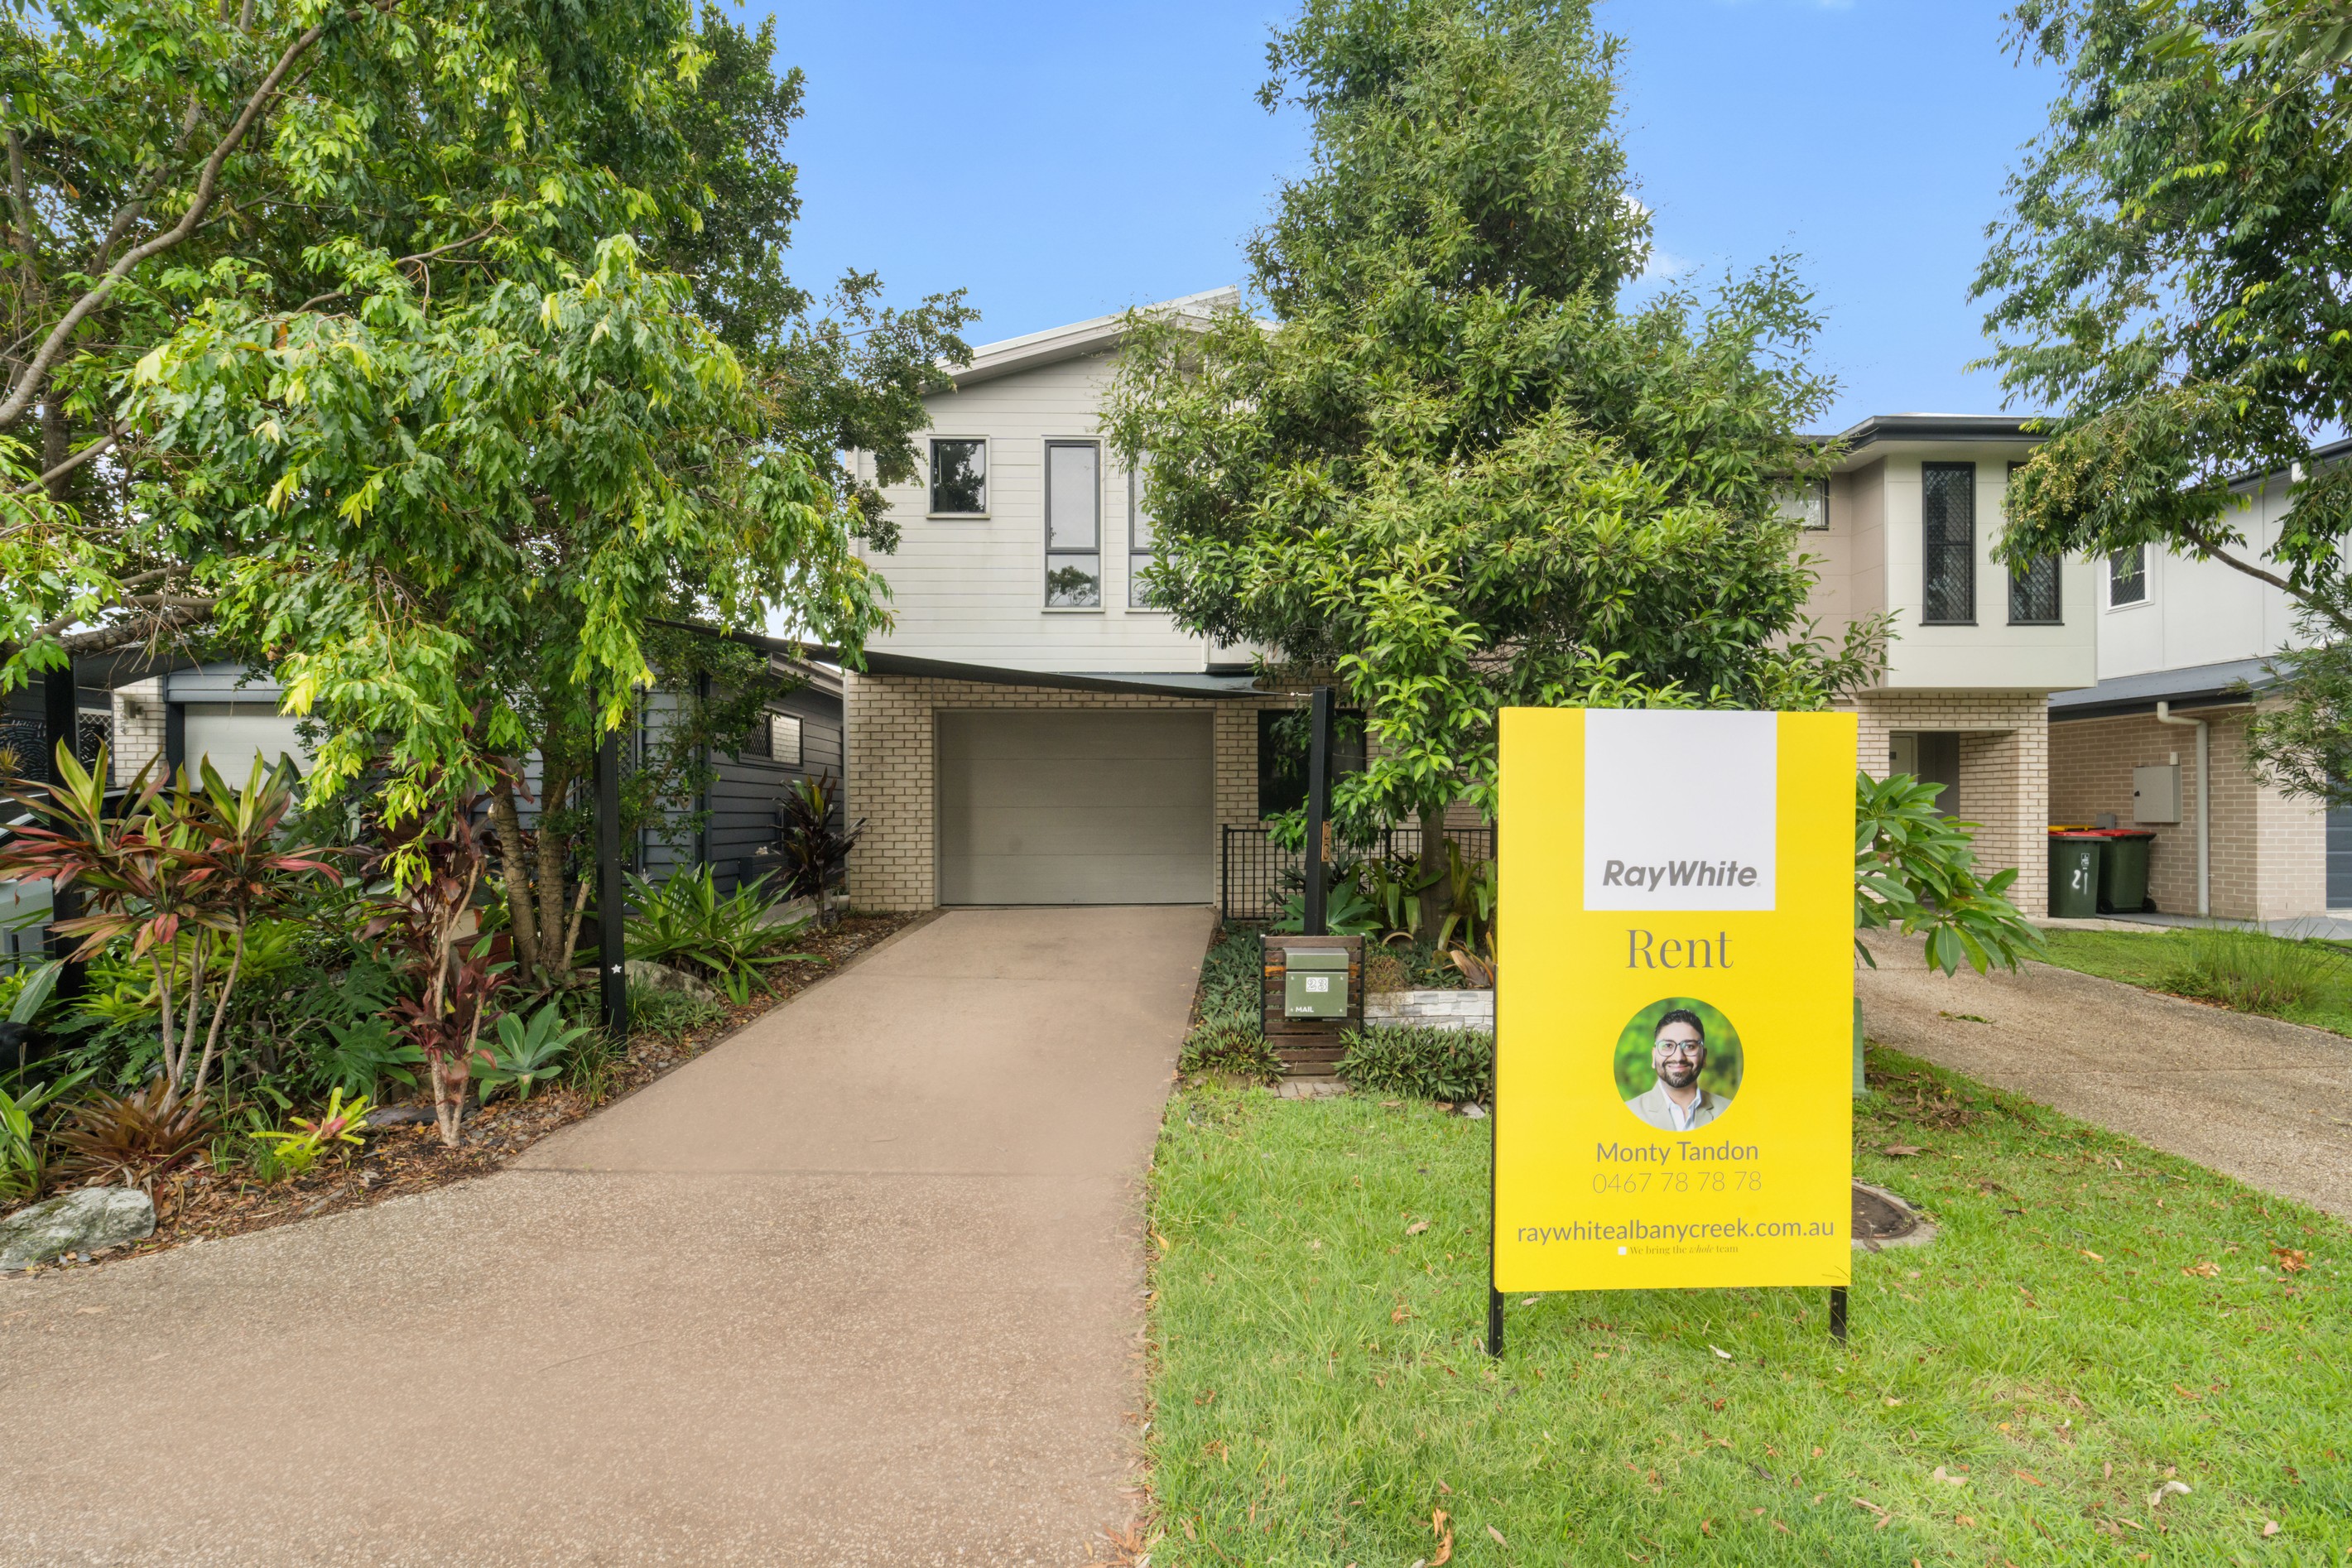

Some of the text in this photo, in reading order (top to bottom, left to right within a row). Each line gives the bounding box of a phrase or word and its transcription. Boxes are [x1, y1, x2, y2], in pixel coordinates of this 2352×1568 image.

[1626, 929, 1734, 969] Rent
[1306, 979, 1328, 991] 23
[1597, 1140, 1758, 1166] Monty Tandon
[1592, 1171, 1763, 1194] 0467 78 78 78
[1517, 1217, 1835, 1246] raywhitealbanycreek.com.au
[1629, 1244, 1739, 1256] We bring the whole team
